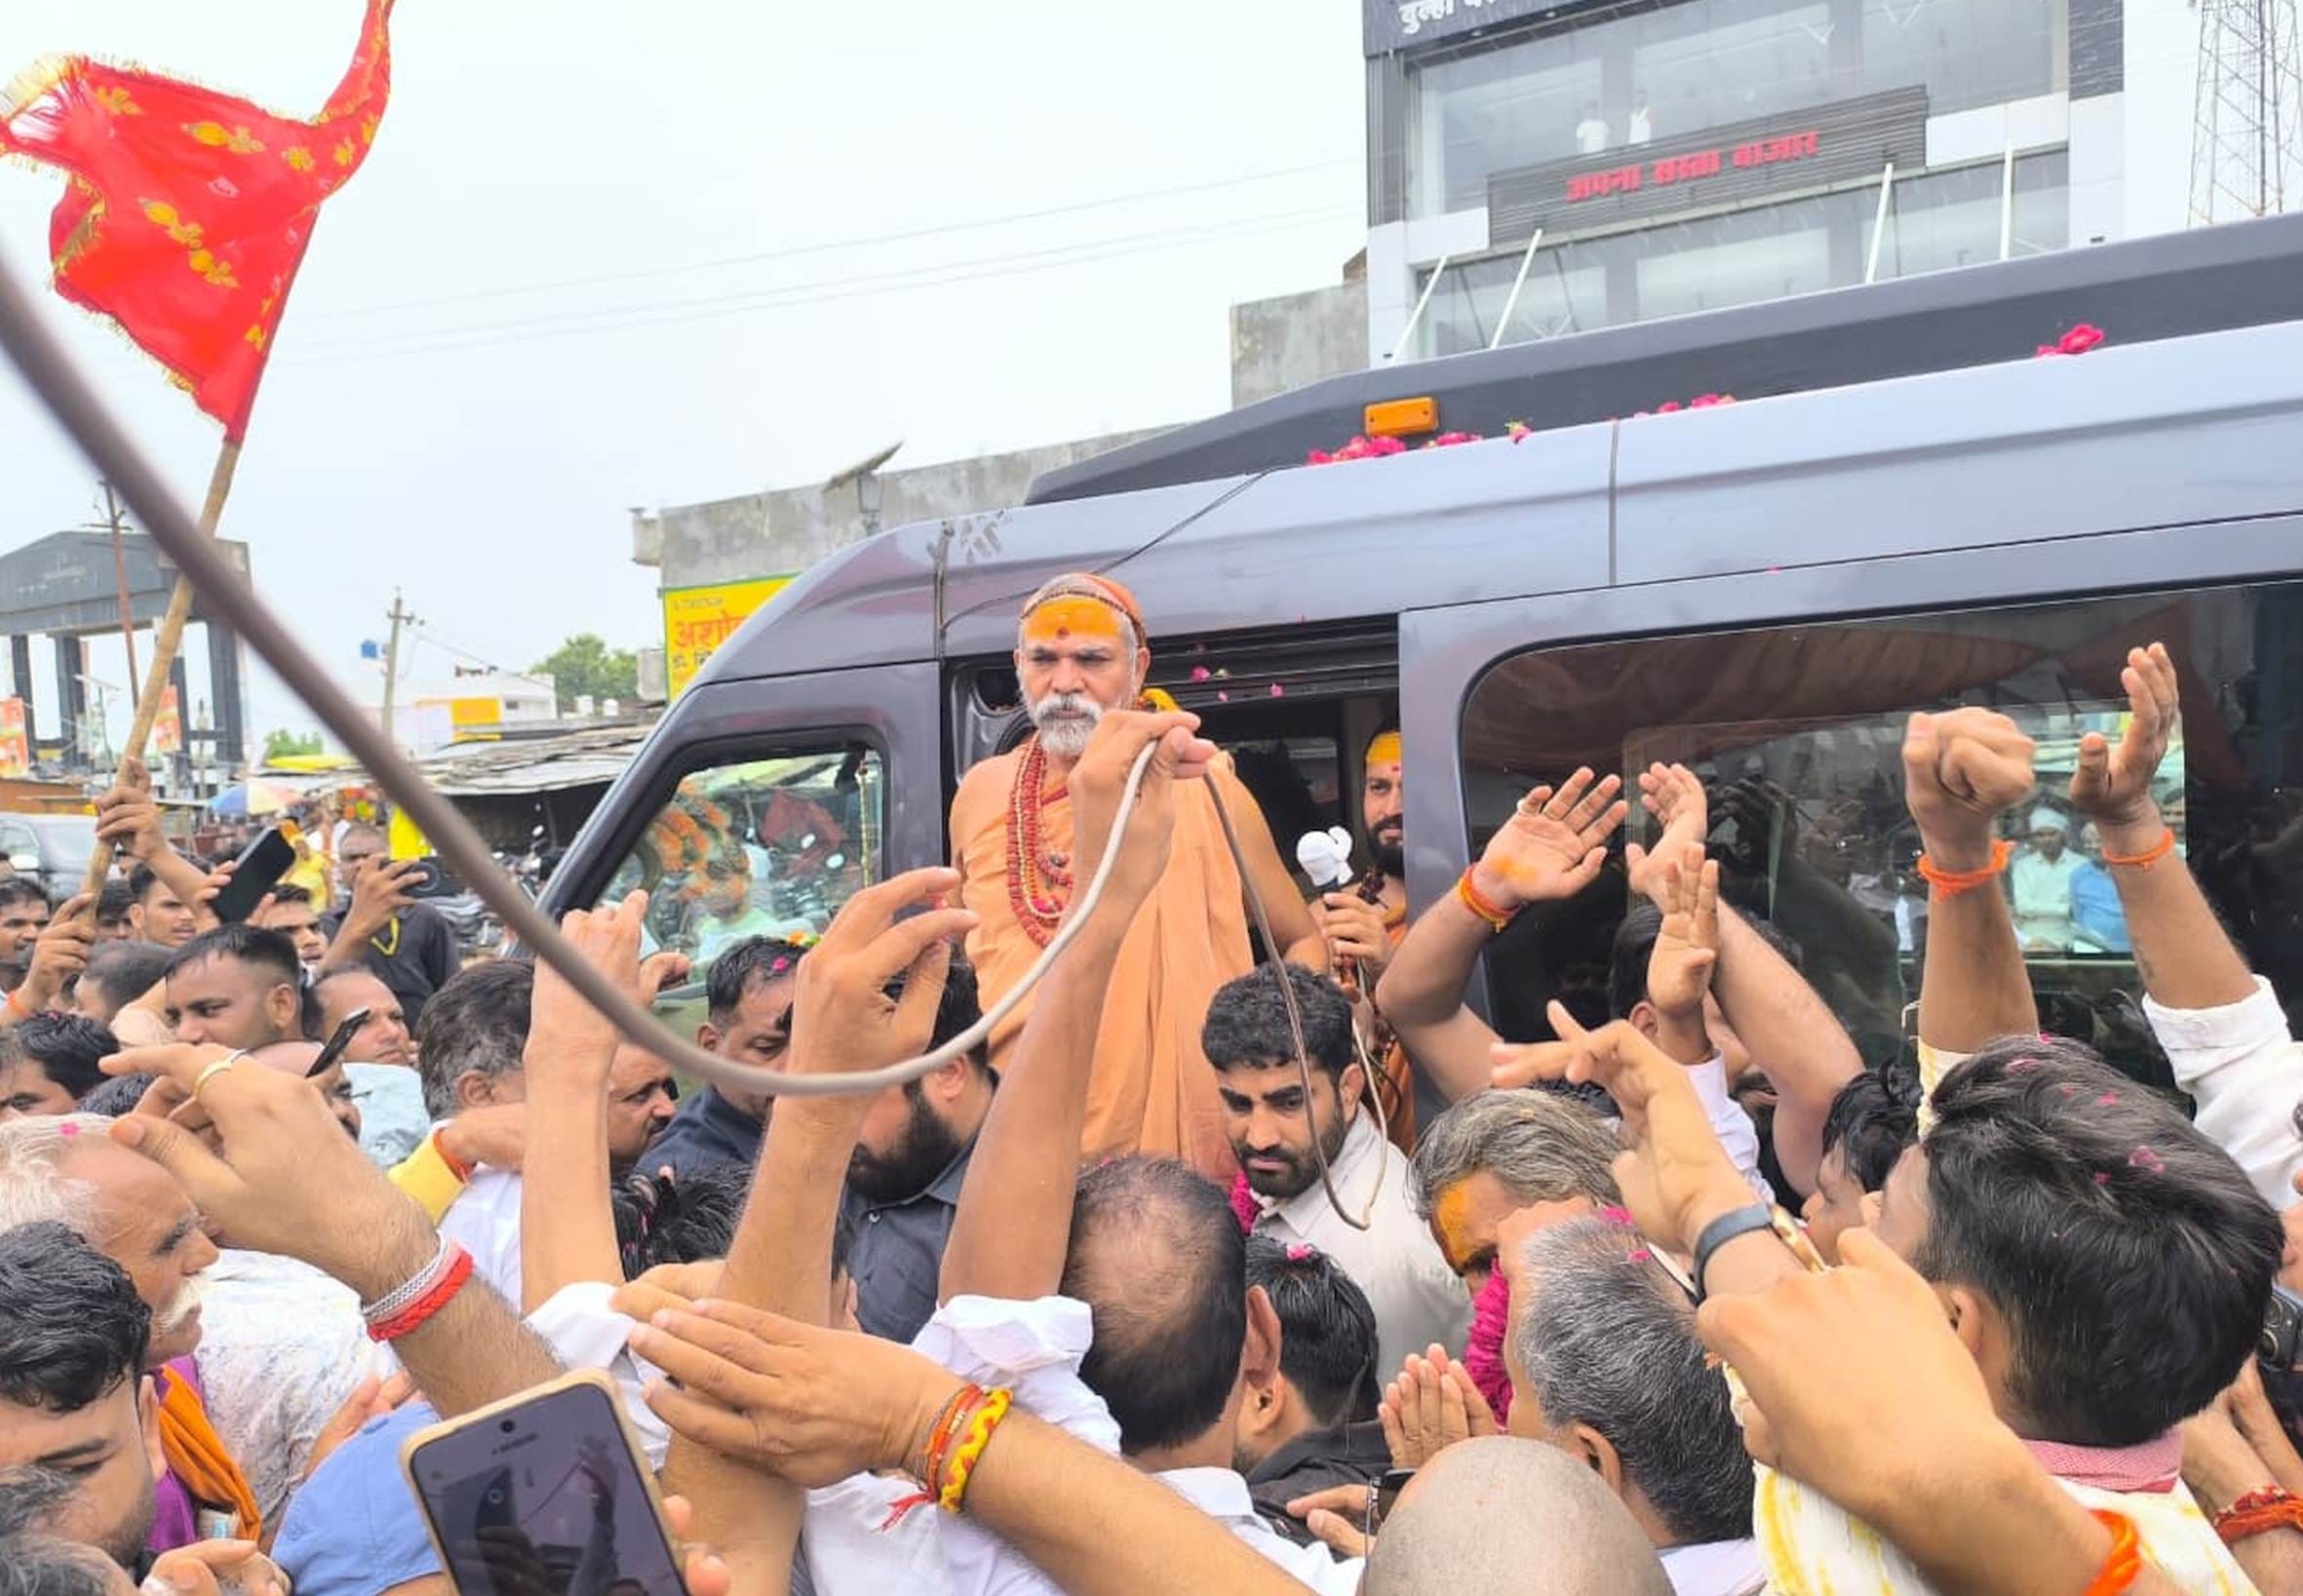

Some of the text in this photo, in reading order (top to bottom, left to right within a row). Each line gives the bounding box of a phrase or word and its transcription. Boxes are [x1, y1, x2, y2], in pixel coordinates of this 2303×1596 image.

[1568, 166, 1641, 201] अपना
[1733, 131, 1817, 168] बाजार
[675, 609, 746, 647] अशो
